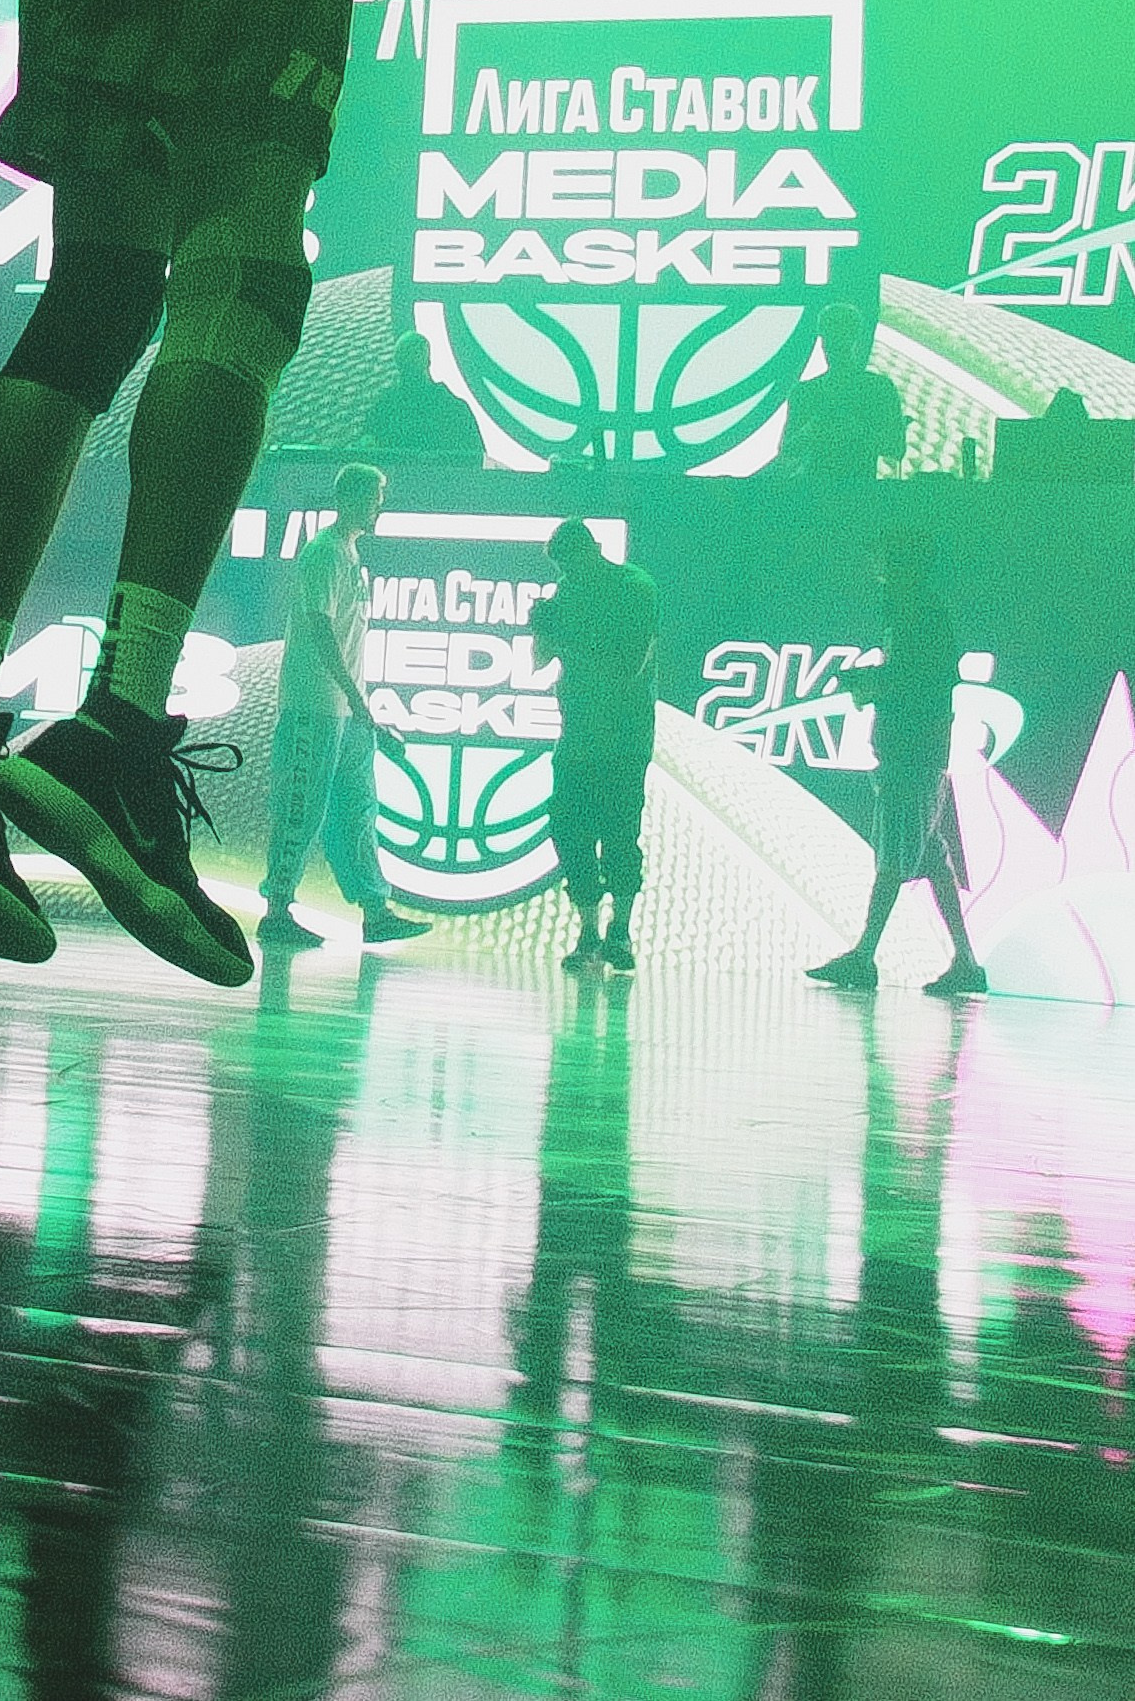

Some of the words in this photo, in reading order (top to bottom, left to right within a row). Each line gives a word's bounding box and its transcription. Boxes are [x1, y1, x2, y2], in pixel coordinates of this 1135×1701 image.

[416, 147, 858, 220] MEDIA
[412, 228, 860, 285] BASKET
[361, 566, 440, 622] ИГА
[365, 628, 562, 691] EDI
[368, 687, 563, 740] ASKE
